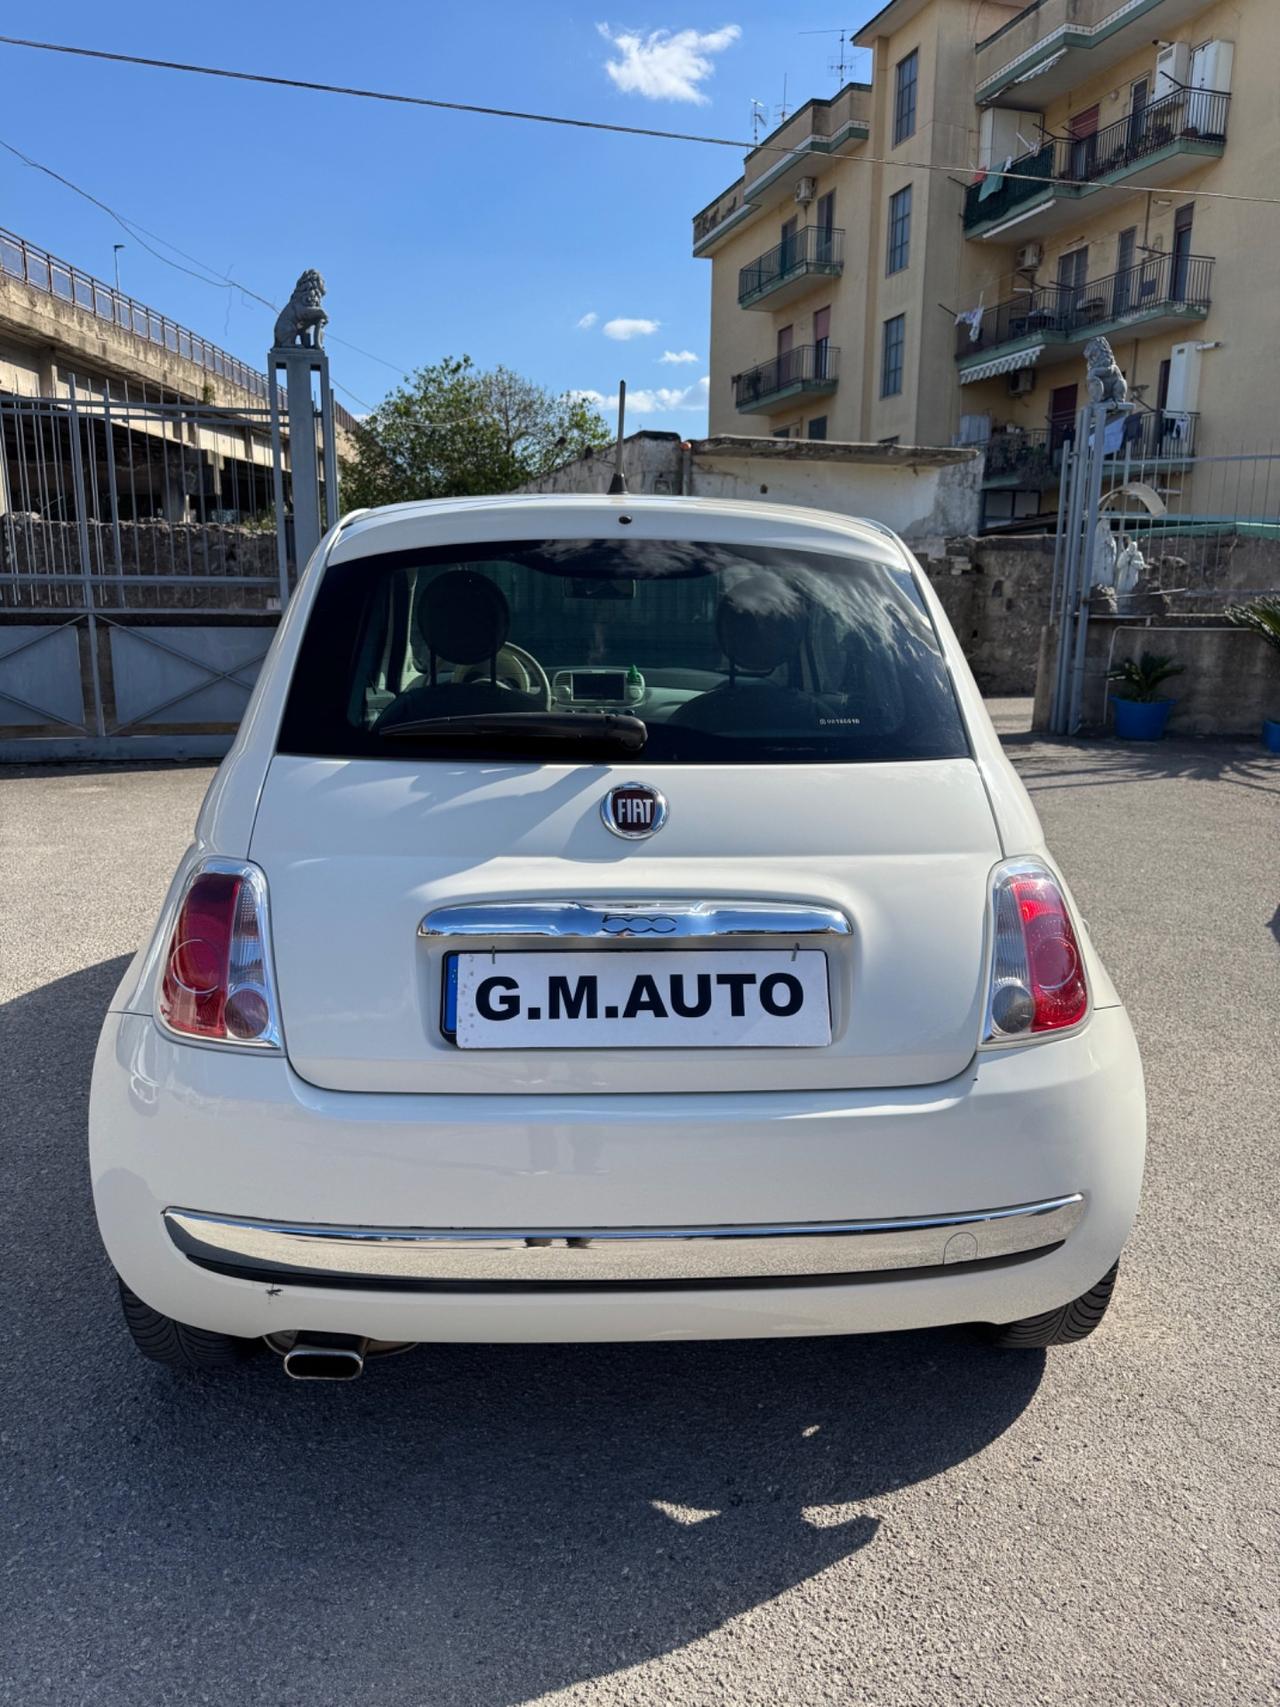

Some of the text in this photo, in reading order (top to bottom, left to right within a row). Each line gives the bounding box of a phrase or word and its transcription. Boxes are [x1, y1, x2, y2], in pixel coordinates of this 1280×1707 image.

[617, 798, 653, 823] FIAT
[602, 913, 677, 934] 500
[475, 972, 804, 1021] G.M.AUTO
